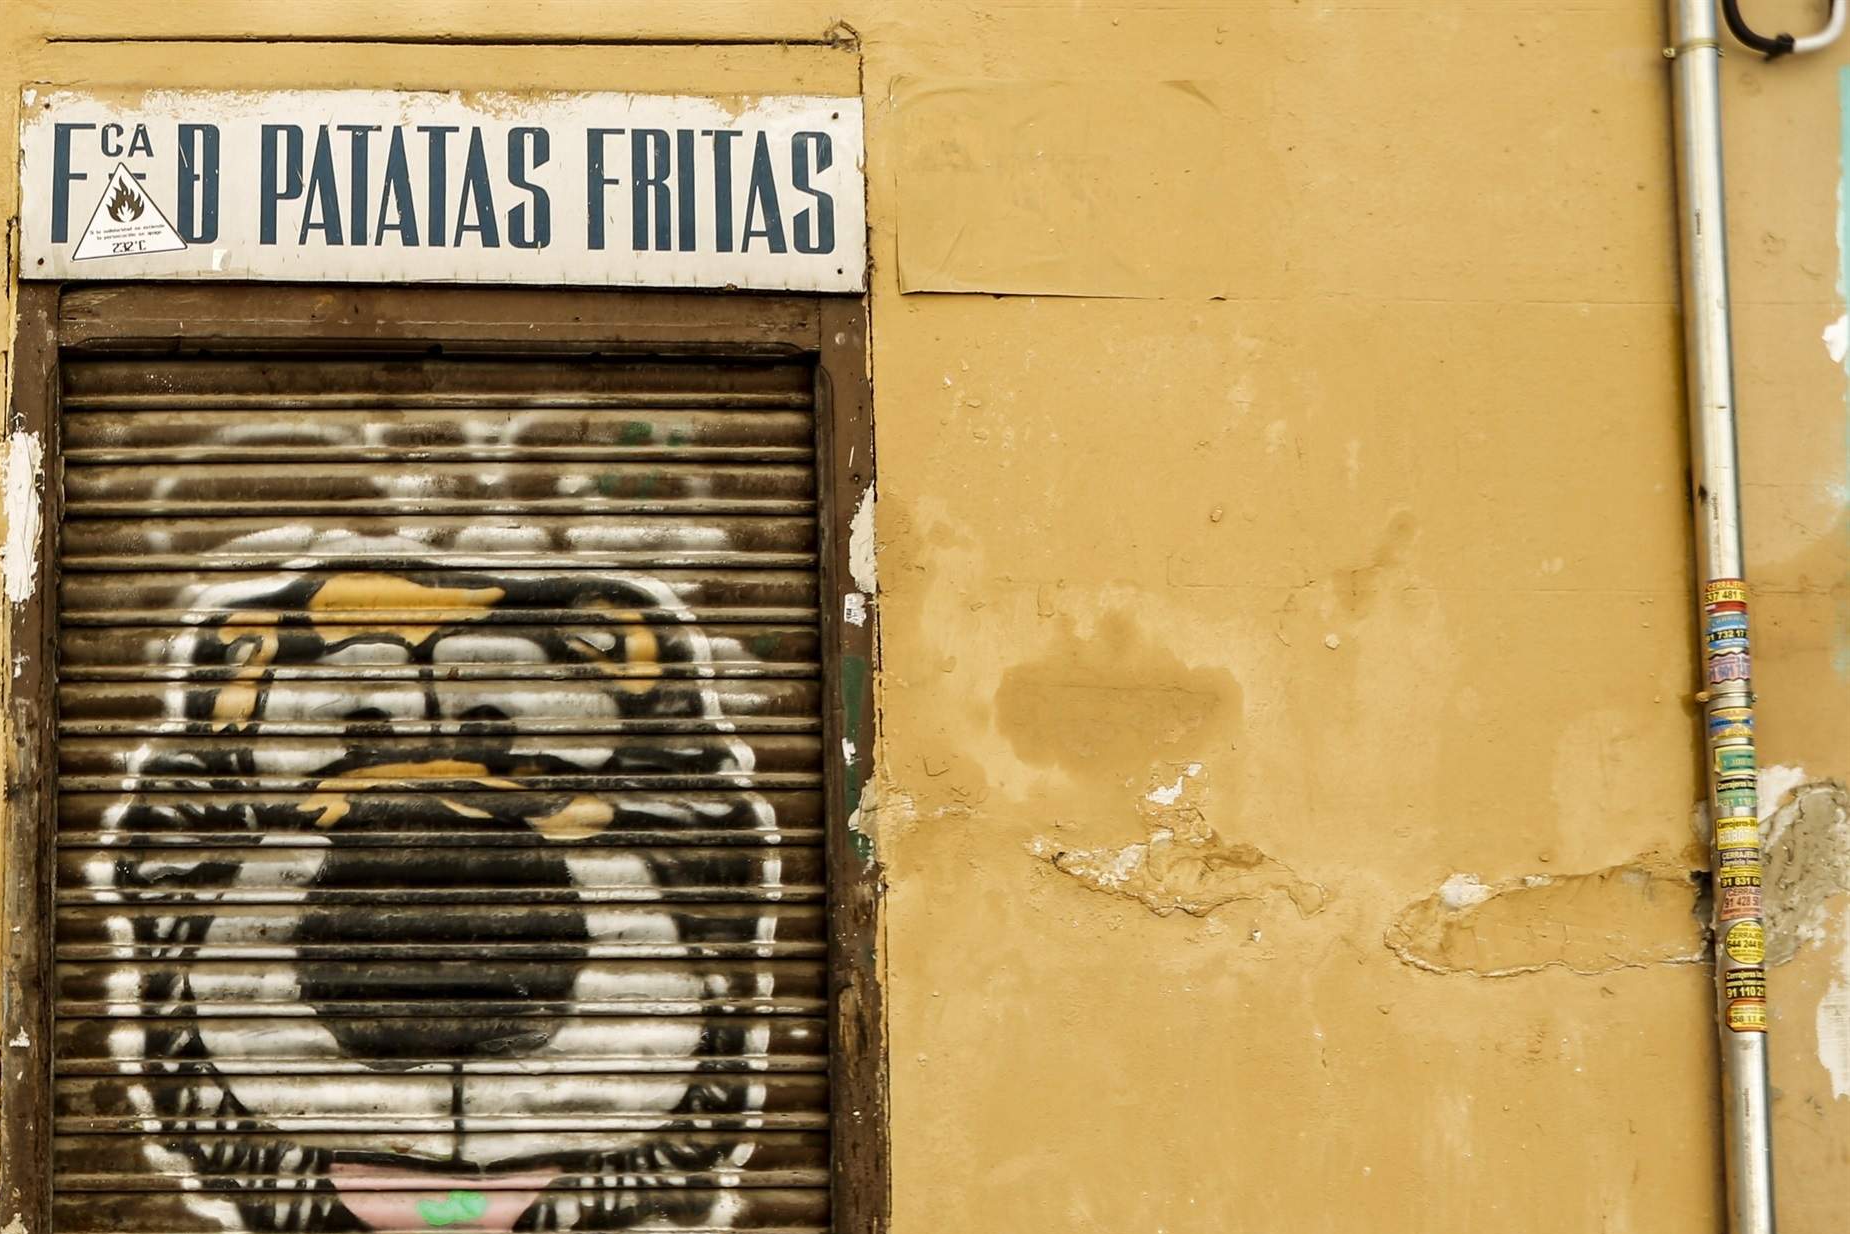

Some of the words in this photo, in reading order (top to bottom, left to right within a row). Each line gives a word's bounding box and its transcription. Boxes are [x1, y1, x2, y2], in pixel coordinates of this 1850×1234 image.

[260, 124, 551, 249] PATATAS
[587, 128, 836, 254] FRITAS
[1735, 877, 1750, 886] 831
[1727, 988, 1737, 998] 91
[1739, 986, 1756, 997] 110
